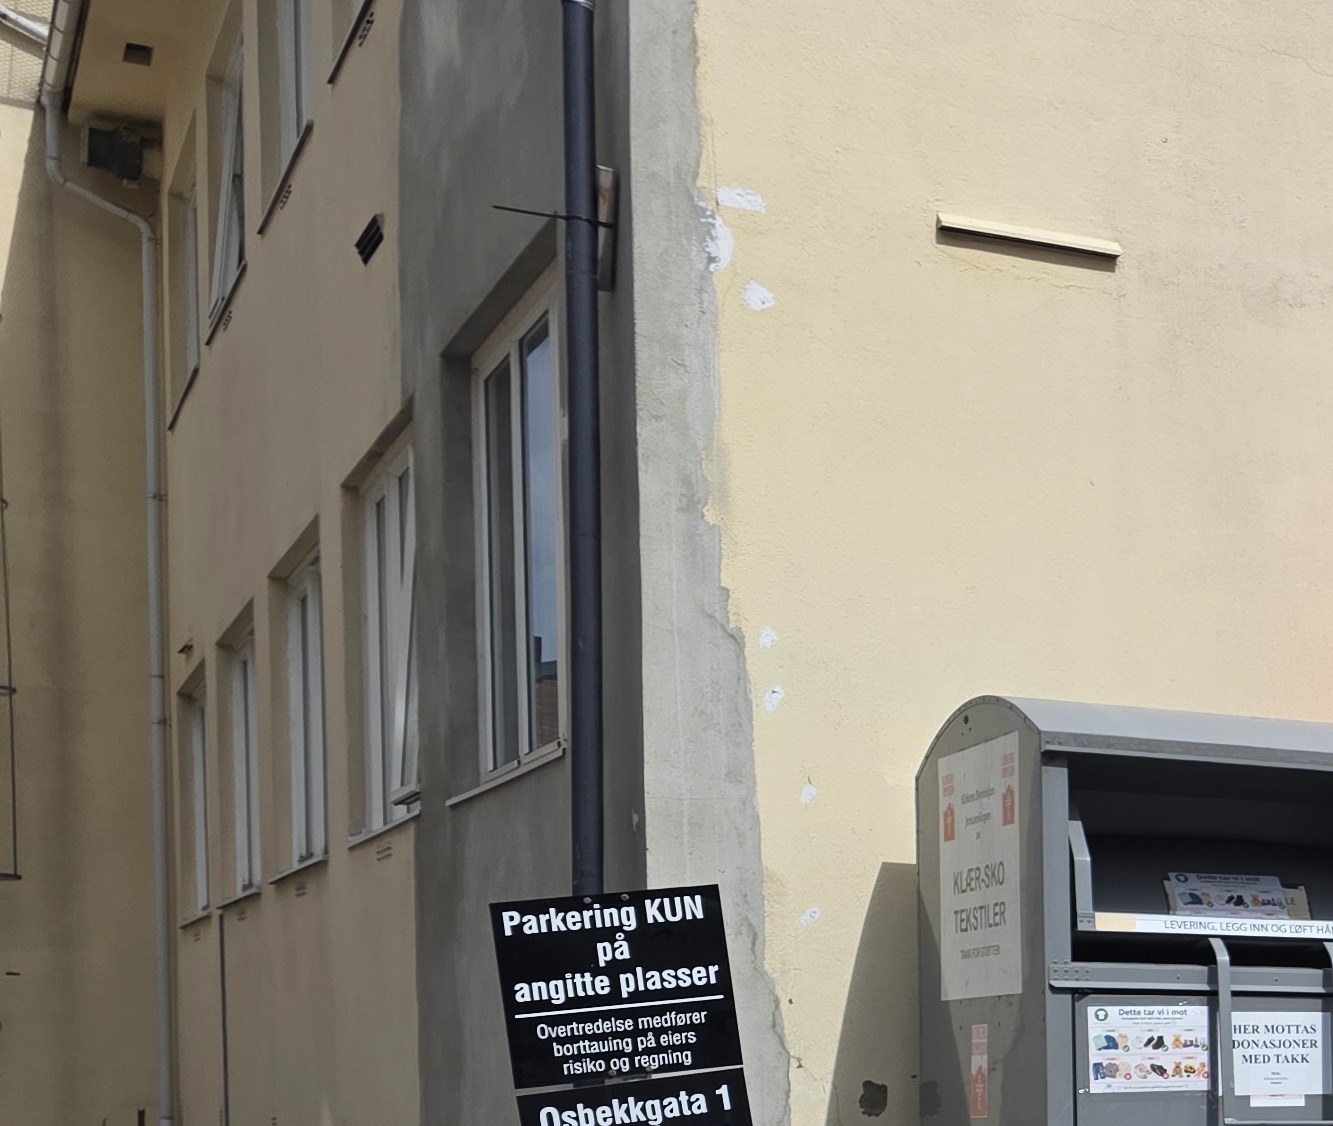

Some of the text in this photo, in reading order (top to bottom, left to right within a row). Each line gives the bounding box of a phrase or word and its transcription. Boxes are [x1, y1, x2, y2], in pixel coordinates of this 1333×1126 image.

[953, 860, 1005, 896] KLÆR-SKO
[502, 894, 704, 936] Parkering KUN
[953, 901, 1007, 935] TEKSTILER
[1164, 920, 1217, 932] LEVERING,
[1220, 922, 1247, 932] LEGG
[1250, 923, 1269, 933] INN
[1271, 925, 1286, 934] OG
[1289, 924, 1314, 935] LØFT
[597, 932, 630, 967] på
[514, 963, 719, 1005] angitte plasser
[537, 1008, 707, 1040] Overtredelse medfører
[1118, 1008, 1141, 1016] Dette
[1143, 1008, 1156, 1016] tar
[1157, 1008, 1164, 1016] vi
[1171, 1008, 1187, 1016] mot
[1233, 1024, 1317, 1034] HER MOTTAS
[553, 1029, 697, 1057] borttauing på eiers
[1232, 1039, 1318, 1049] DONASJONER
[563, 1048, 692, 1075] risiko og regning
[1242, 1053, 1310, 1064] MED TAKK
[715, 1085, 733, 1111] 1
